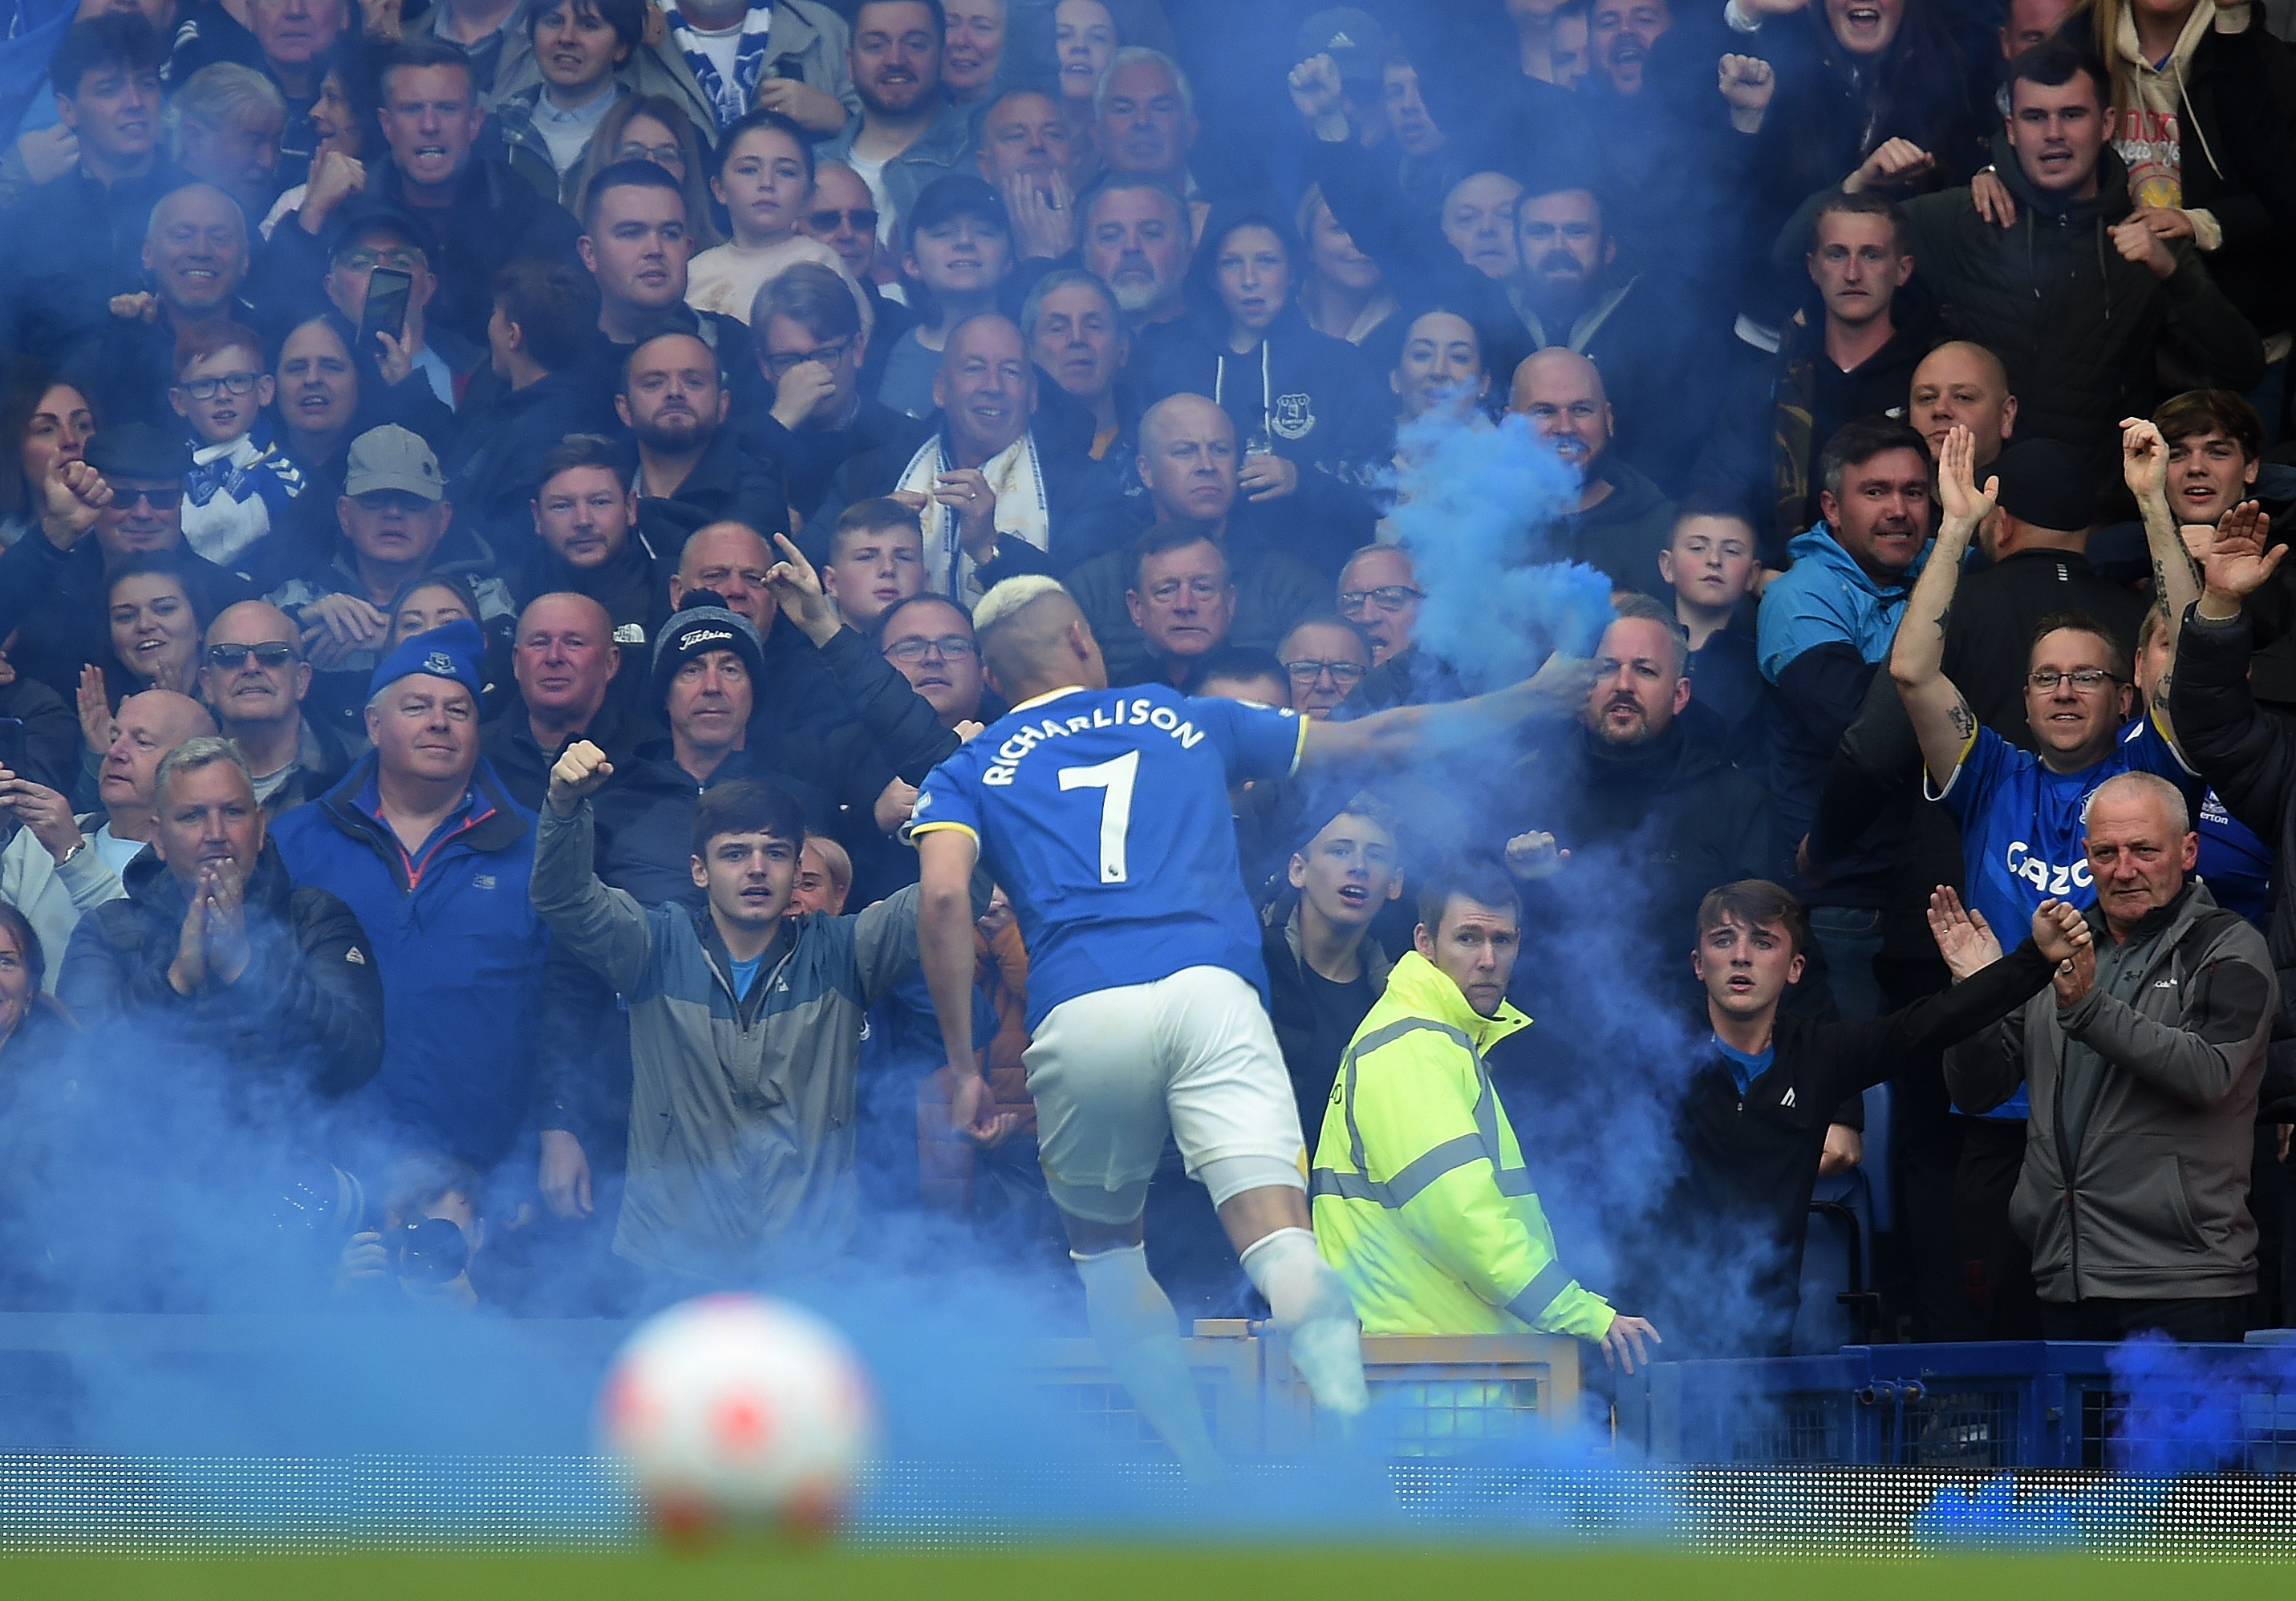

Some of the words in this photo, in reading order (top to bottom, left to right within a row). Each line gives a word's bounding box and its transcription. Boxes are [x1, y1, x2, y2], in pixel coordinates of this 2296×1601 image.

[982, 699, 1205, 786] RICHARLISON
[1057, 748, 1140, 883] 7
[2200, 812, 2229, 825] erton
[2007, 841, 2094, 895] Cazo
